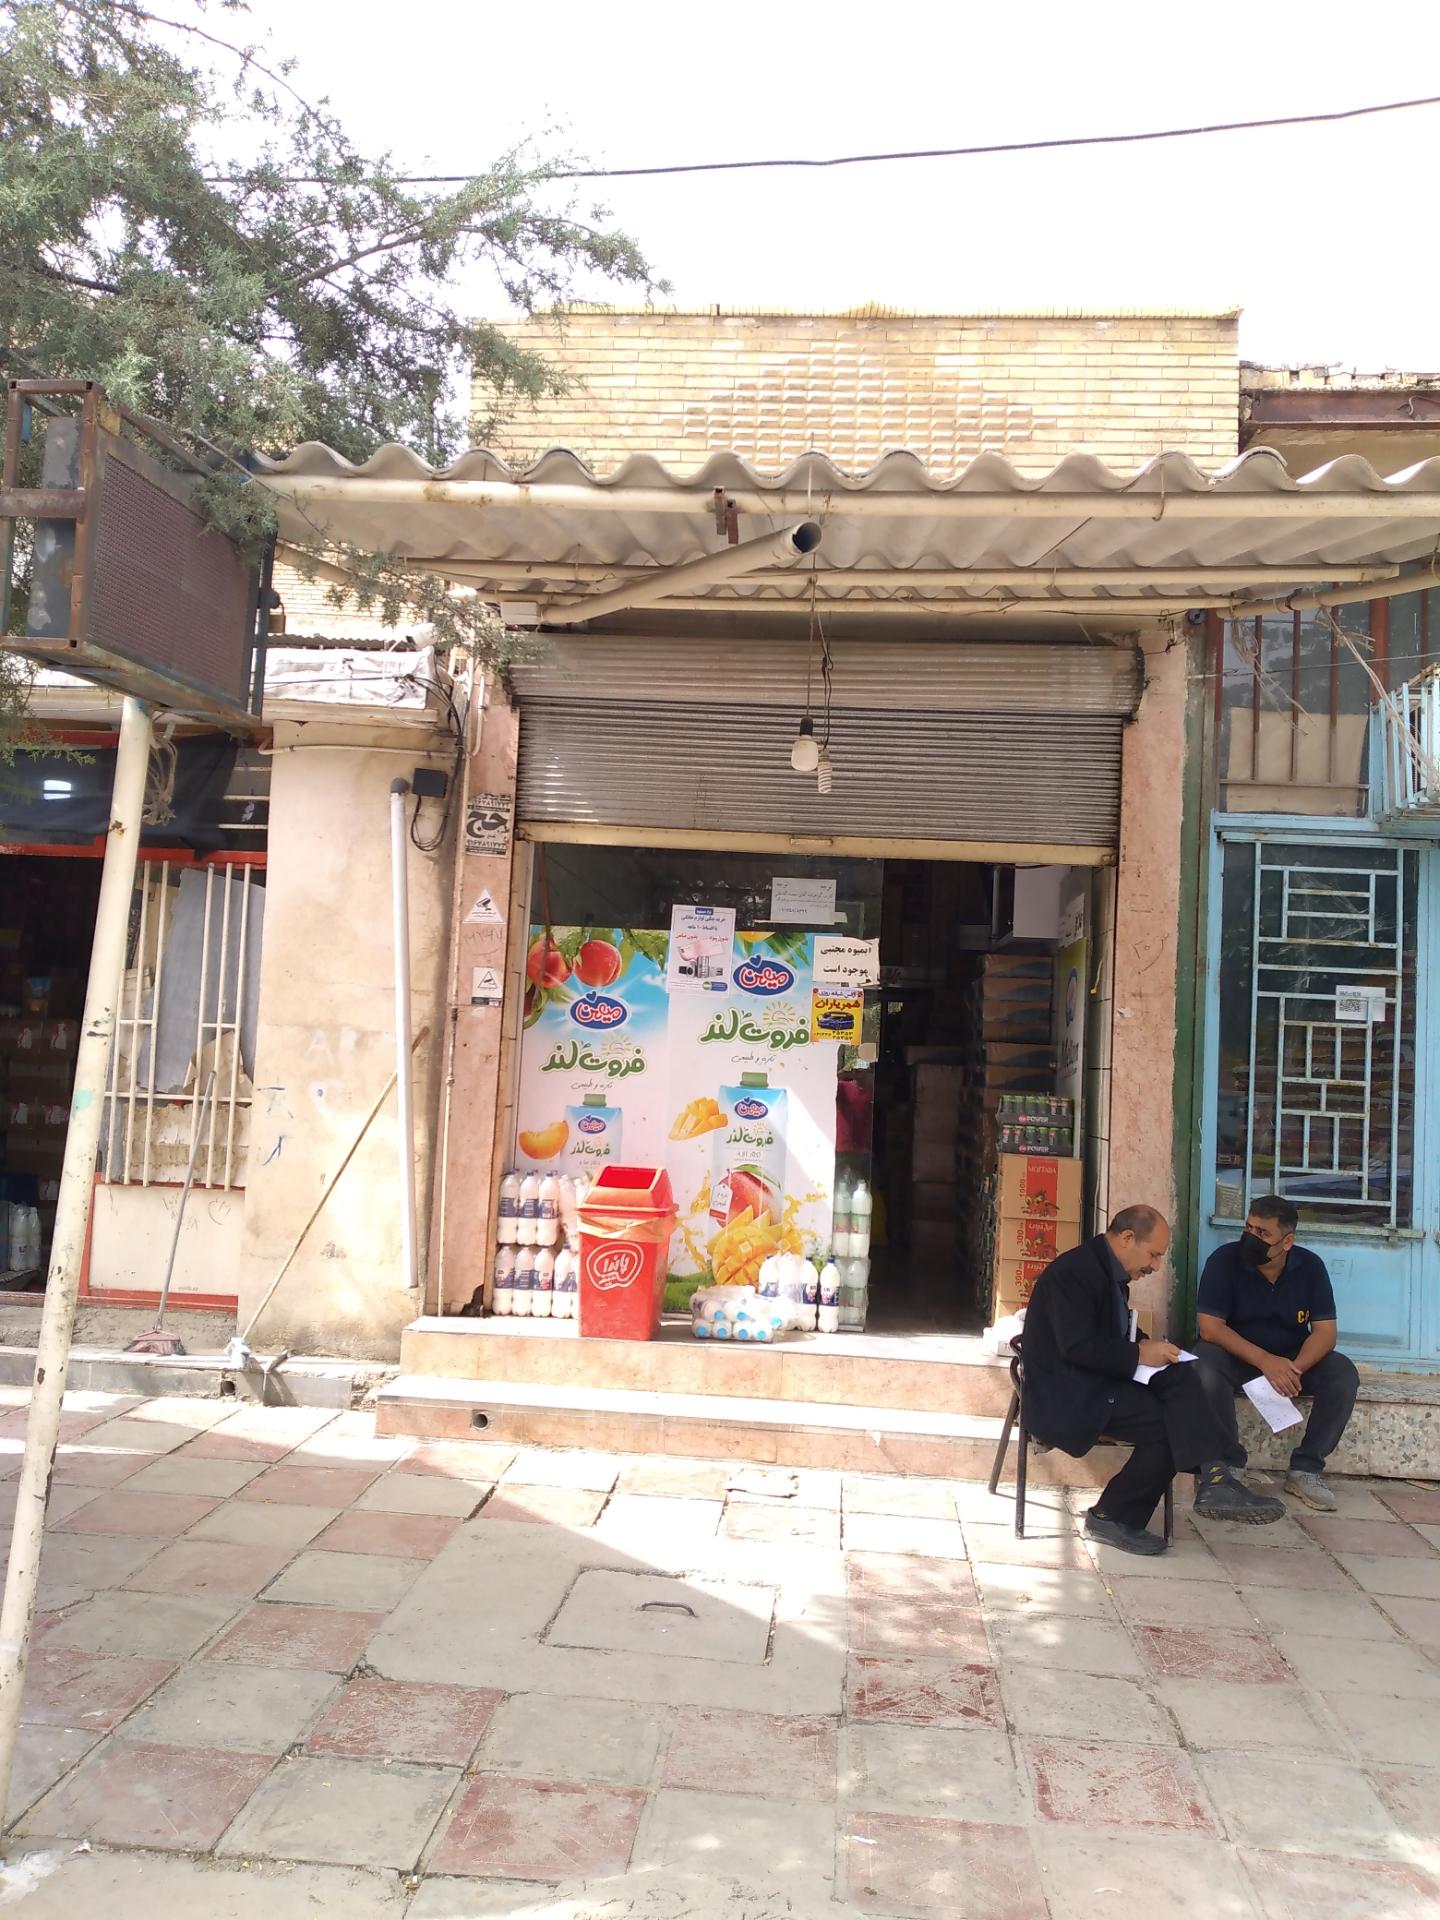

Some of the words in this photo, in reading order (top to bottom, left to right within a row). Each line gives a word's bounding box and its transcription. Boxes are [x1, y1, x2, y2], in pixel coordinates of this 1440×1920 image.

[466, 811, 508, 838] حج
[820, 944, 845, 955] مجتبی
[738, 966, 789, 989] میهن
[823, 964, 841, 973] است
[842, 966, 868, 978] موجود
[576, 1002, 623, 1023] میهن
[700, 1007, 739, 1043] لند
[540, 1039, 579, 1072] لند
[1026, 1115, 1049, 1123] POWER
[1026, 1145, 1049, 1153] POWER
[1016, 1229, 1024, 1247] 300
[1014, 1269, 1023, 1287] 300
